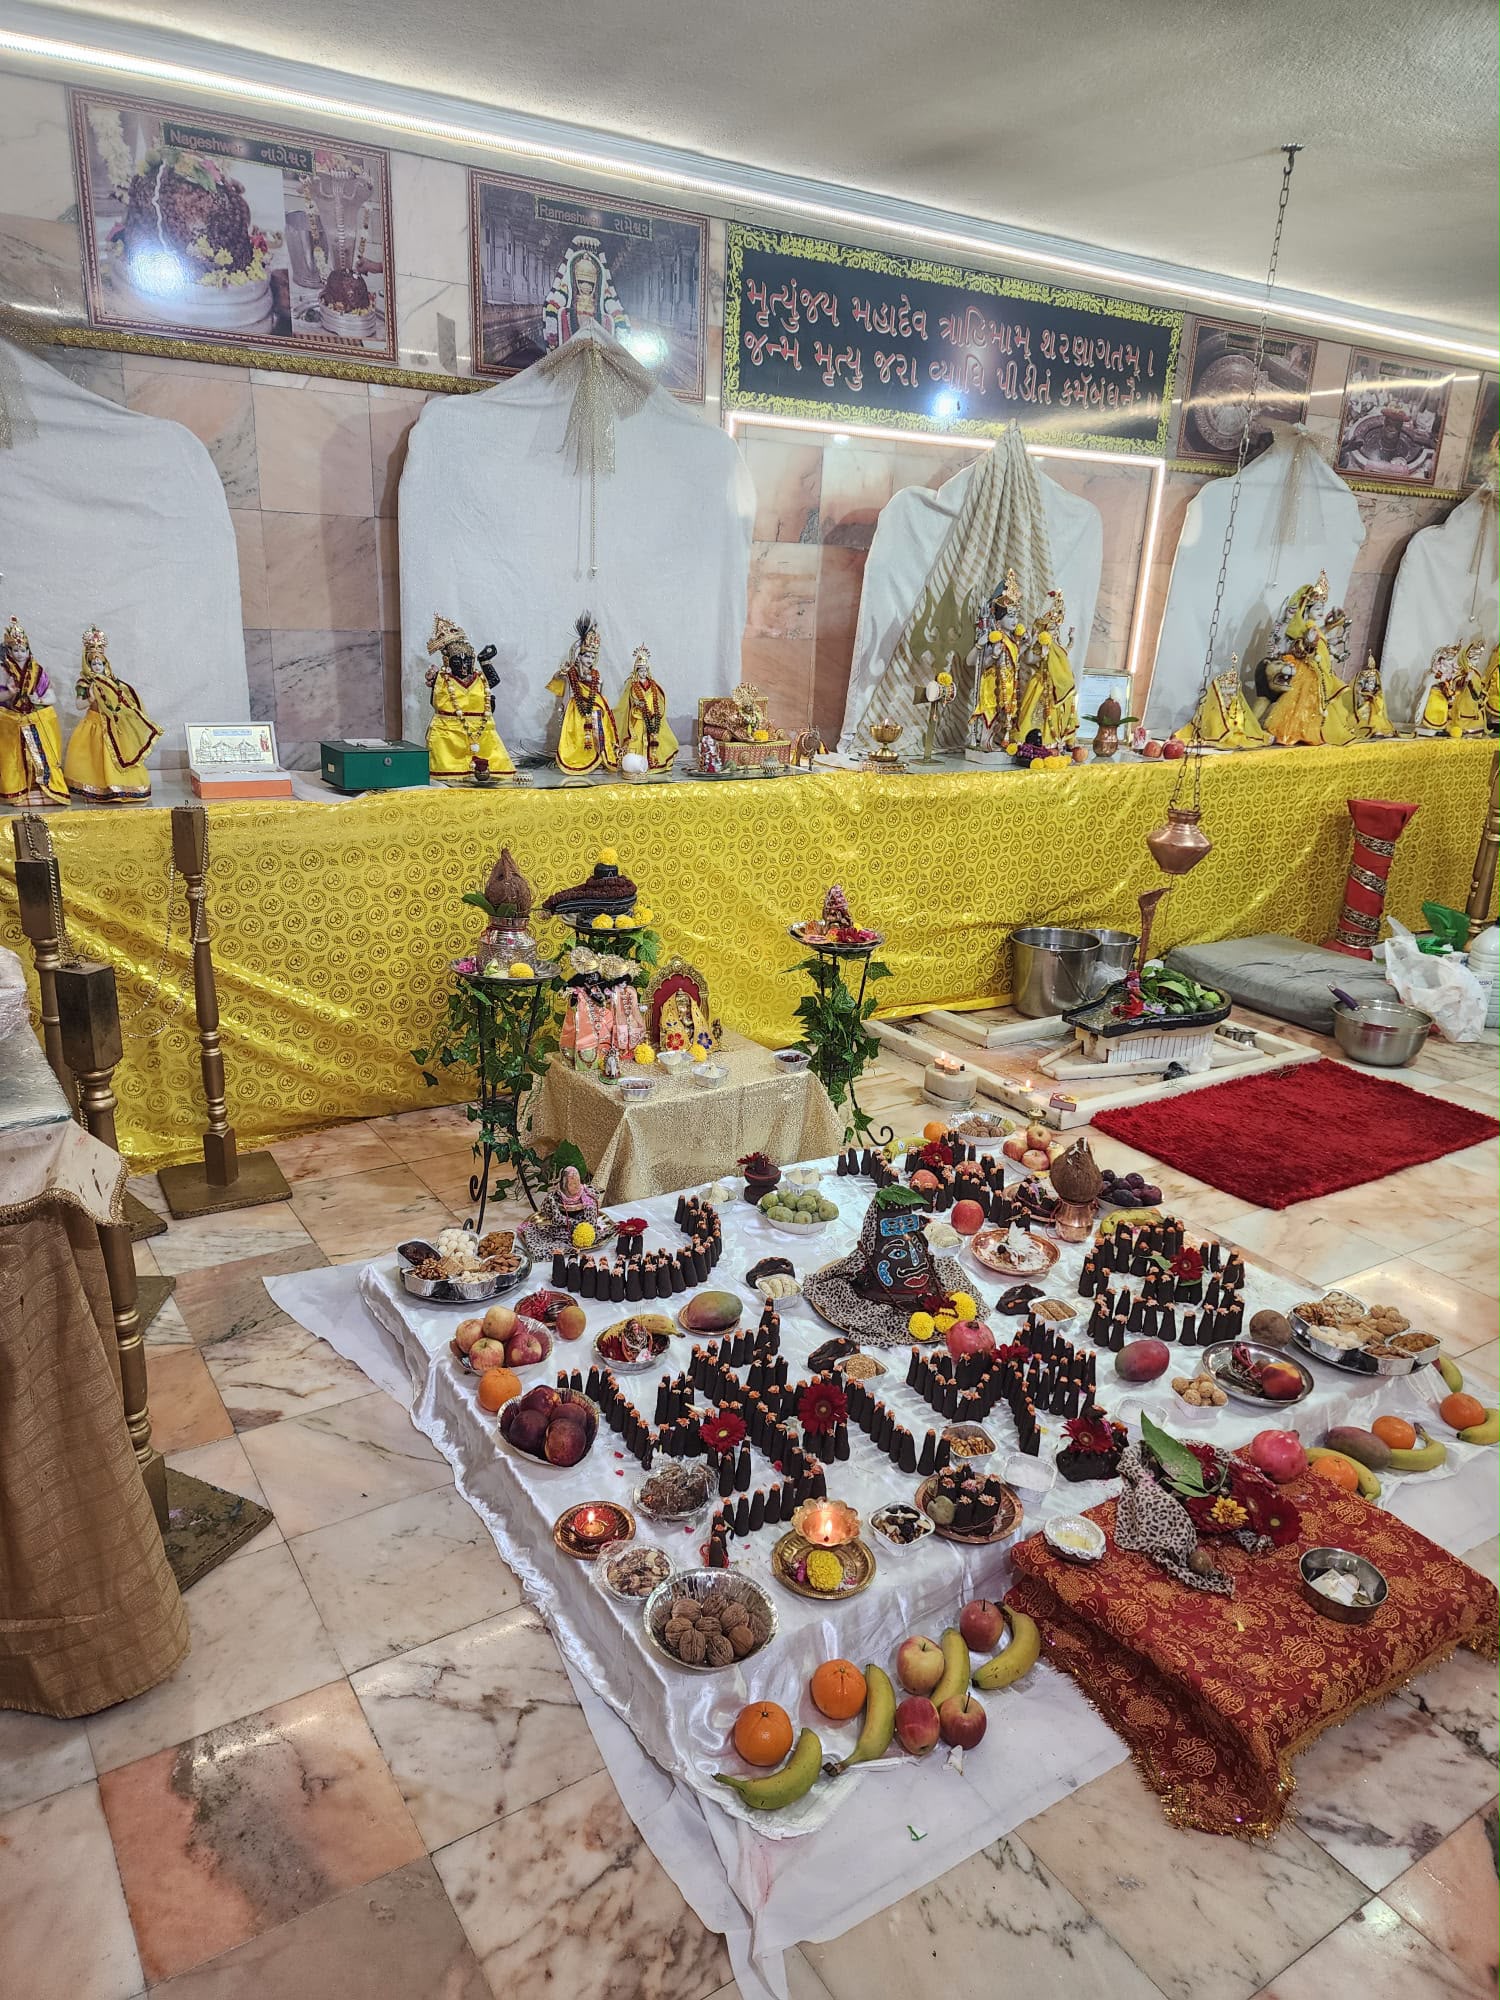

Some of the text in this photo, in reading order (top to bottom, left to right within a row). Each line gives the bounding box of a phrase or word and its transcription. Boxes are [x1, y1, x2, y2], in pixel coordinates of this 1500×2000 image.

[851, 293, 929, 340] મહાદેવ
[744, 331, 802, 371] જન્મ
[814, 341, 864, 391] મૃત્યુ
[873, 350, 918, 388] જરા
